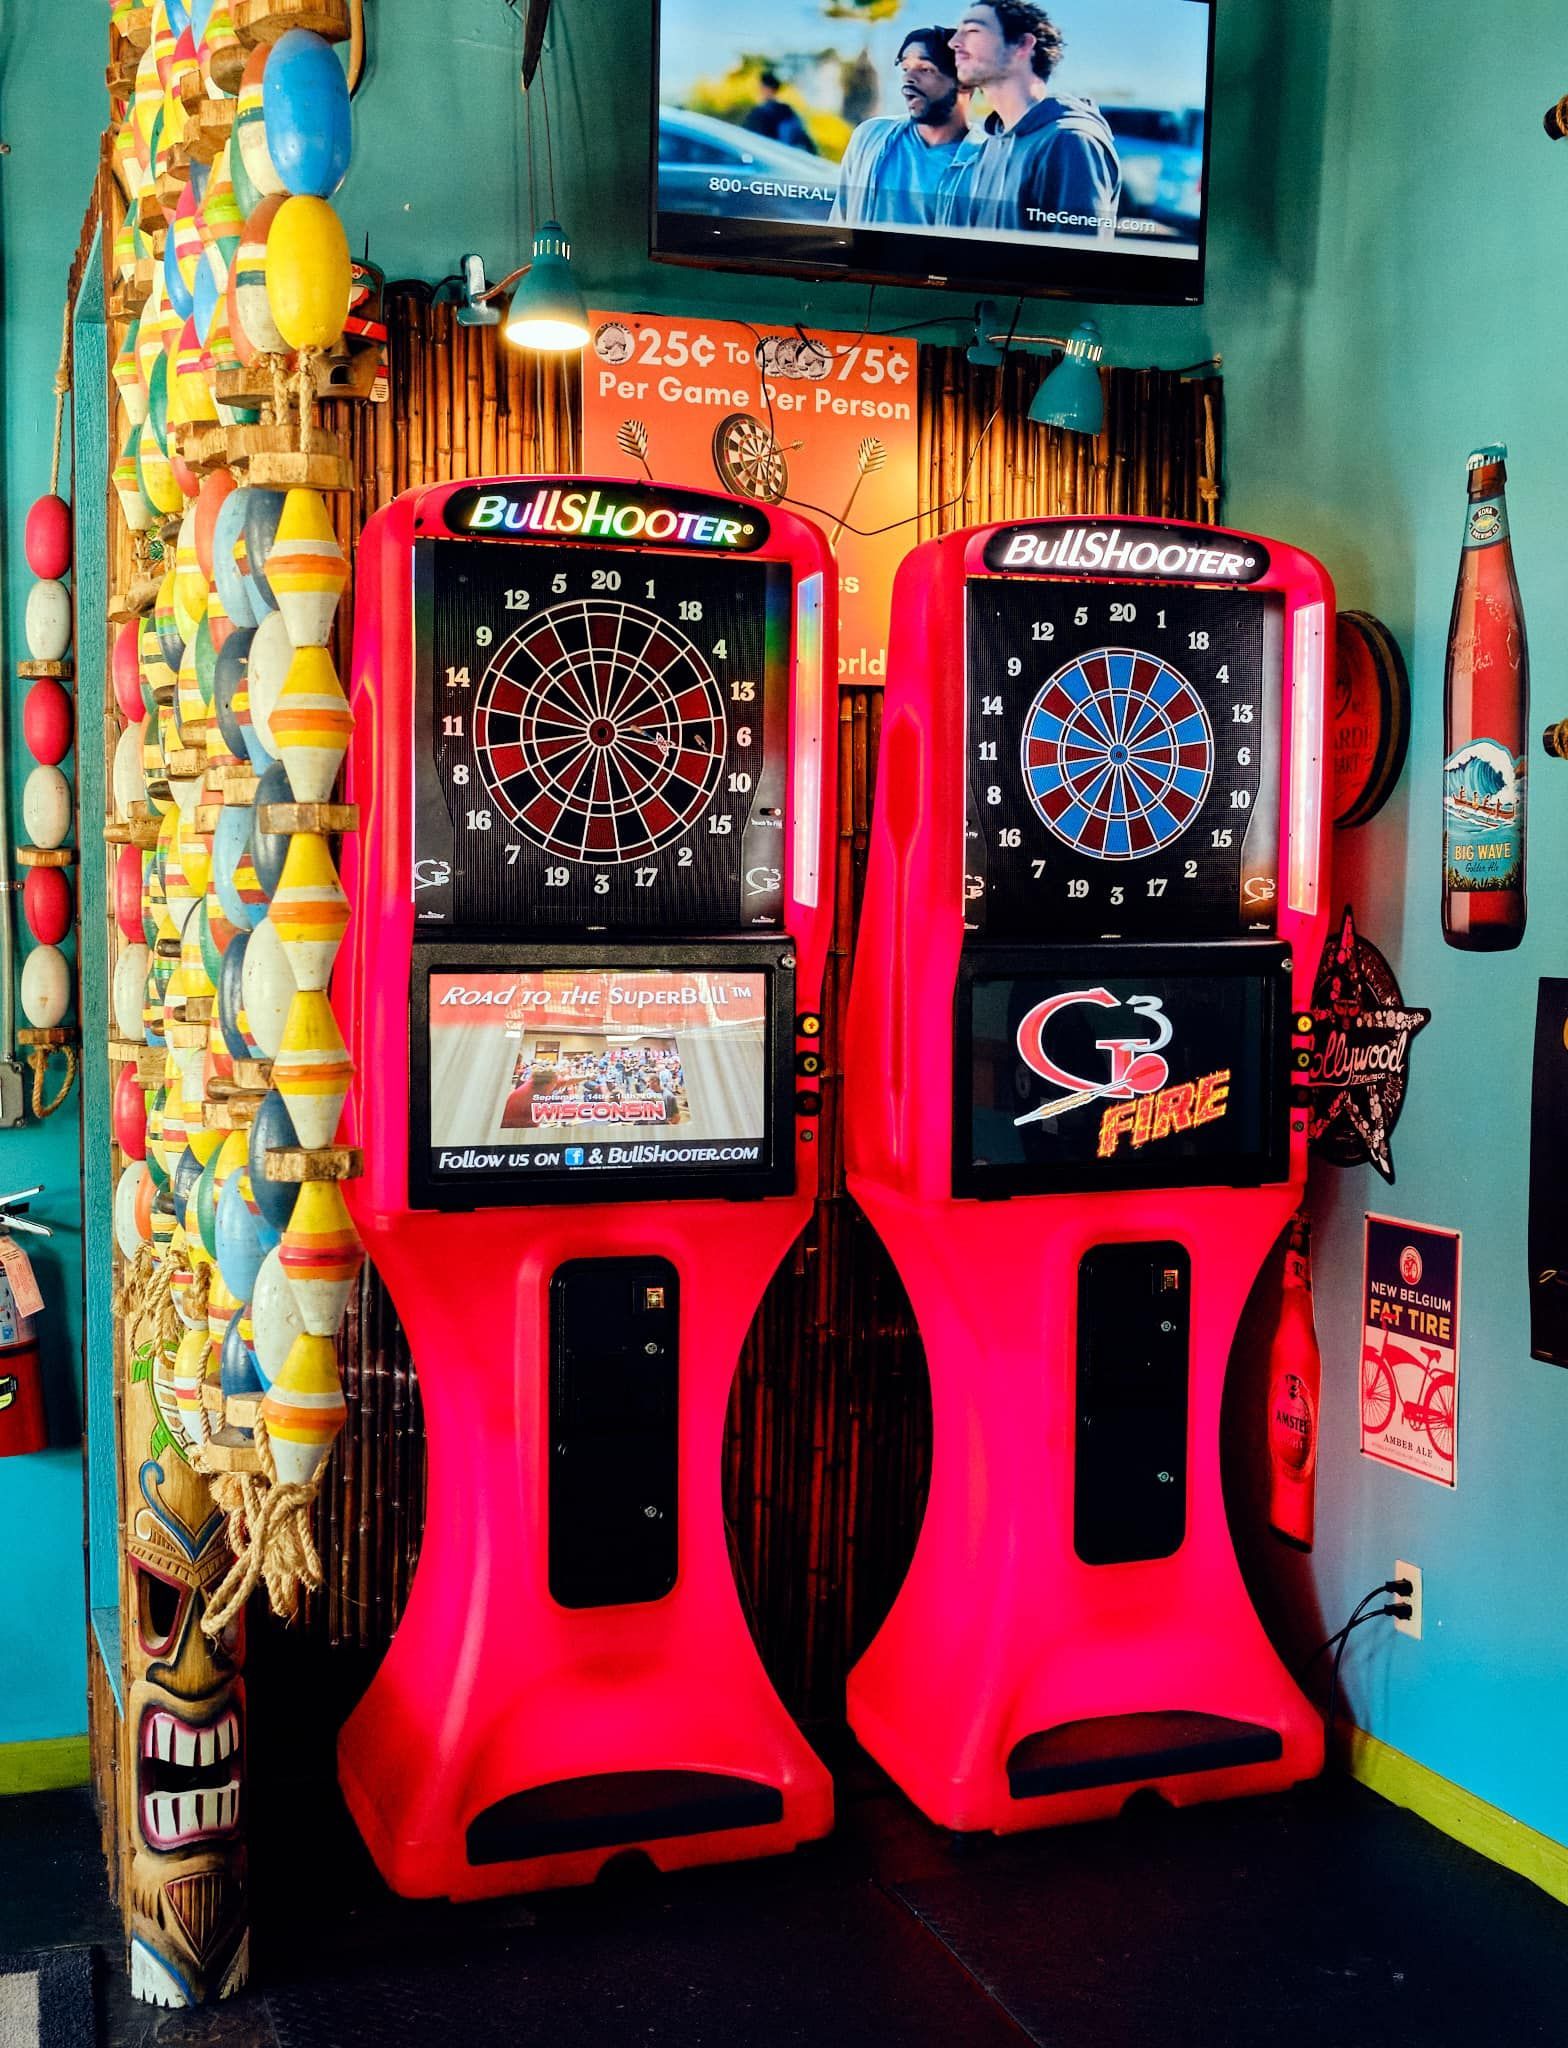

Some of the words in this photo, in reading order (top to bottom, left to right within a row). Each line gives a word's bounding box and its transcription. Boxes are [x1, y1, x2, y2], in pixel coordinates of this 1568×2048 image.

[709, 177, 834, 201] 800-GENERAL
[1026, 207, 1156, 233] TheGeneral.com
[637, 328, 716, 368] 25¢
[723, 341, 750, 365] To
[599, 371, 649, 398] Per
[657, 376, 750, 408] Game
[759, 384, 807, 412] Per
[815, 388, 911, 421] Person
[551, 573, 568, 594] 5
[591, 569, 622, 591] 20
[645, 579, 656, 599] 1
[504, 589, 530, 610] 12
[678, 600, 703, 622] 18
[1074, 606, 1089, 626] 5
[1109, 603, 1137, 623] 20
[1156, 609, 1167, 629] 1
[475, 626, 493, 647] 9
[1031, 621, 1055, 641] 12
[1187, 631, 1210, 650] 18
[712, 639, 728, 659] 4
[838, 647, 886, 676] orld
[1007, 656, 1022, 677] 9
[445, 666, 471, 688] 14
[1215, 664, 1230, 684] 4
[730, 681, 756, 702] 13
[981, 695, 1004, 716] 14
[1231, 704, 1254, 724] 13
[442, 715, 464, 736] 11
[736, 727, 752, 747] 6
[978, 741, 998, 761] 11
[1237, 747, 1251, 766] 6
[453, 764, 470, 785] 8
[728, 772, 751, 793] 10
[986, 785, 1002, 805] 8
[1229, 790, 1251, 809] 10
[466, 810, 492, 831] 16
[708, 814, 733, 835] 15
[998, 828, 1022, 848] 16
[1211, 829, 1233, 848] 15
[504, 844, 521, 865] 7
[677, 847, 693, 867] 2
[1455, 844, 1474, 860] BIG
[1478, 842, 1511, 859] WAVE
[544, 866, 570, 887] 19
[634, 867, 659, 888] 17
[1031, 859, 1046, 879] 7
[1184, 860, 1198, 878] 2
[593, 873, 610, 894] 3
[1067, 879, 1090, 898] 19
[1146, 878, 1168, 897] 17
[1110, 886, 1125, 905] 3
[440, 985, 519, 1005] Road
[521, 990, 551, 1005] to
[561, 985, 600, 1005] the
[607, 986, 729, 1009] SuperBull
[1309, 1030, 1405, 1086] ollywood
[532, 1100, 666, 1123] WISCONSIN
[1096, 1068, 1232, 1158] FIRE
[438, 1151, 504, 1169] Follow
[508, 1153, 529, 1166] us
[534, 1152, 560, 1166] on
[588, 1149, 603, 1165] &
[607, 1145, 759, 1164] BullShooter.com
[1371, 1280, 1398, 1298] NEW
[1400, 1288, 1451, 1312] BELGIUM
[1370, 1298, 1403, 1326] FAT
[1408, 1308, 1451, 1341] TIRE
[1383, 1434, 1413, 1452] AMBER
[1416, 1446, 1433, 1459] ALE
